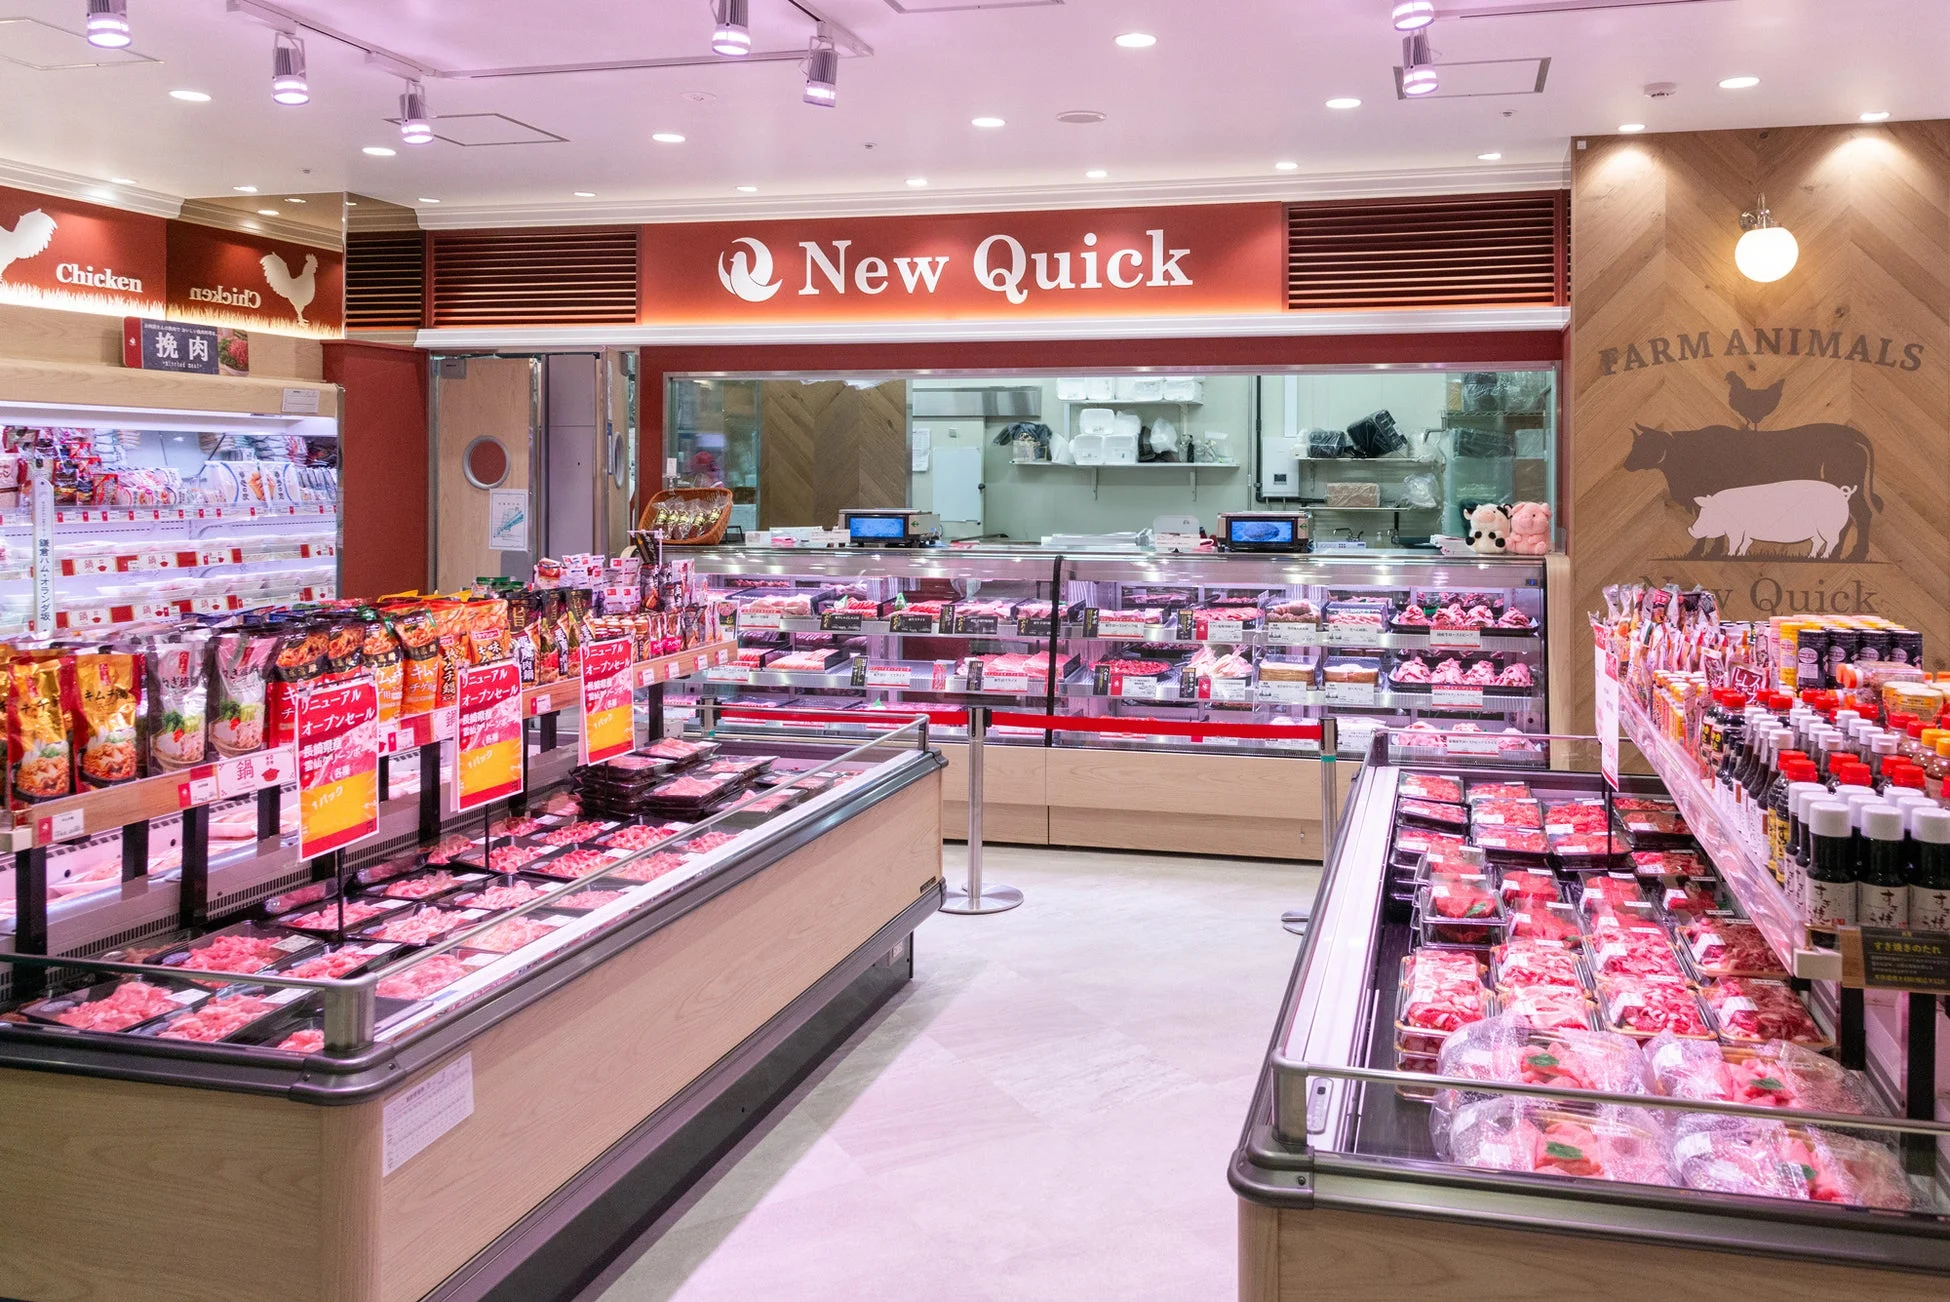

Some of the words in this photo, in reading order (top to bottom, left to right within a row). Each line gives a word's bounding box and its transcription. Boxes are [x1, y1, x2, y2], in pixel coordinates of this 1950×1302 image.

[56, 263, 143, 293] Chicken
[798, 239, 949, 296] New
[972, 229, 1194, 305] Quick
[1598, 330, 1714, 376] FARM
[1723, 327, 1924, 372] ANIMALS
[1750, 576, 1879, 616] Quick
[462, 668, 508, 689] リニューアル
[301, 688, 362, 715] リニューアル
[462, 684, 519, 707] オープンセール
[302, 706, 376, 736] オープンセール
[1873, 941, 1942, 954] すき焼きのたれ
